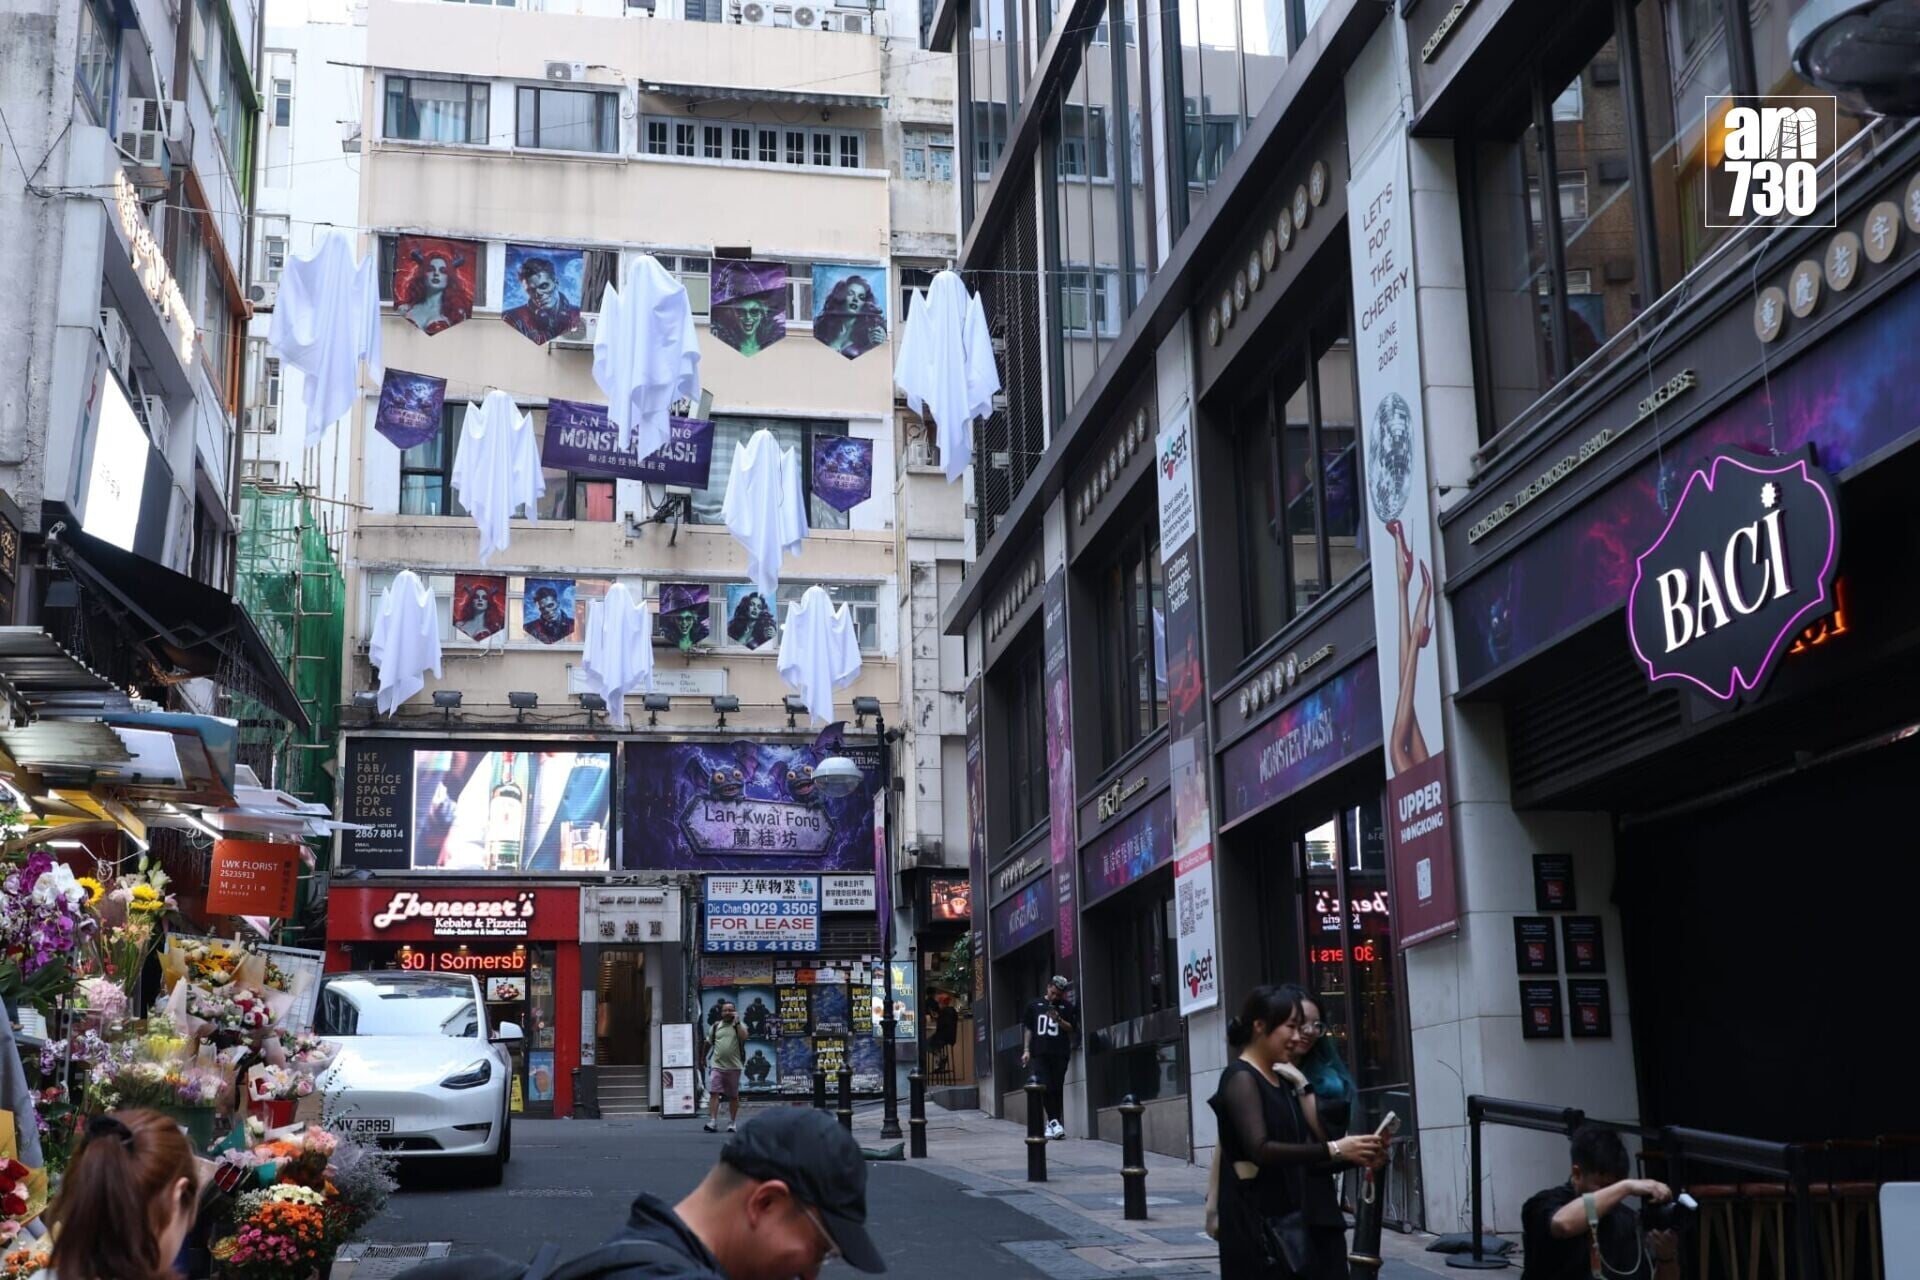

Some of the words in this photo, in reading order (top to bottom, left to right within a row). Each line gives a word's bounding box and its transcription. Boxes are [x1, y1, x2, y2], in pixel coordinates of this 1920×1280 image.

[1363, 182, 1393, 232] LET'S
[1368, 219, 1391, 259] POP
[1370, 250, 1394, 288] THE
[1361, 267, 1409, 331] CHERRY
[1377, 321, 1397, 348] JUNE
[1378, 341, 1398, 372] 2026
[571, 414, 599, 428] LAN
[357, 752, 378, 762] LKF
[357, 774, 402, 784] OFFICE
[356, 785, 397, 795] SPACE
[356, 796, 380, 806] FOR
[1399, 780, 1442, 823] UPPER
[355, 807, 392, 817] LEASE
[705, 806, 735, 822] Lan
[743, 809, 780, 826] Kwai
[786, 811, 820, 832] Fong
[355, 829, 379, 839] 2867
[380, 829, 403, 838] 8814
[1400, 812, 1444, 844] HONGKONG
[732, 828, 798, 847] 蘭桂坊
[221, 859, 240, 869] LWK
[242, 860, 278, 871] FLORIST
[220, 869, 255, 879] 25235913
[740, 879, 796, 895] 美華物業
[373, 892, 534, 929] Ebeneezer's
[708, 902, 719, 914] Dic
[723, 903, 742, 914] Chan
[743, 902, 778, 915] 9029
[782, 902, 817, 915] 3505
[435, 917, 472, 928] Kebabs
[474, 918, 484, 928] &
[486, 917, 527, 928] Pizzeria
[710, 918, 747, 930] FOR
[755, 917, 815, 930] LEASE
[707, 941, 758, 951] 3188
[765, 941, 817, 951] 4188
[401, 952, 424, 970] 30
[440, 952, 526, 970] Somersb
